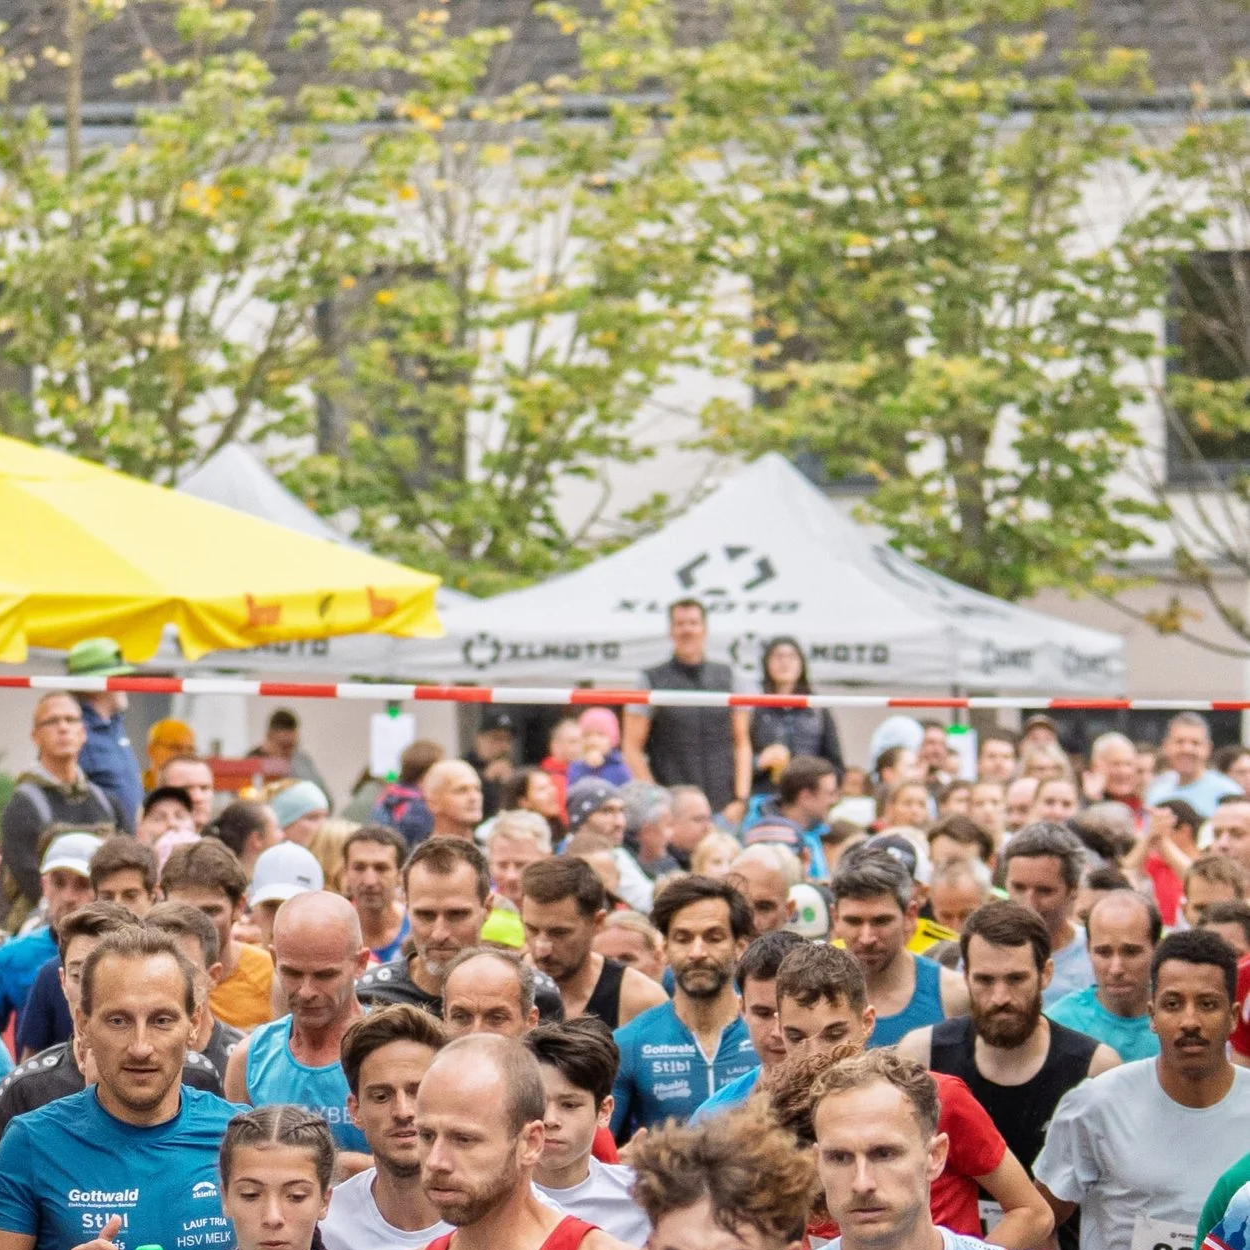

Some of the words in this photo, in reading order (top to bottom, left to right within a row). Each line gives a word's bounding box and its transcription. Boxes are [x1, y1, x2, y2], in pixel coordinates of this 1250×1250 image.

[68, 1188, 139, 1202] Gottwald
[183, 1218, 208, 1231] LAUF
[177, 1234, 202, 1248] HSV
[205, 1231, 232, 1245] MELK
